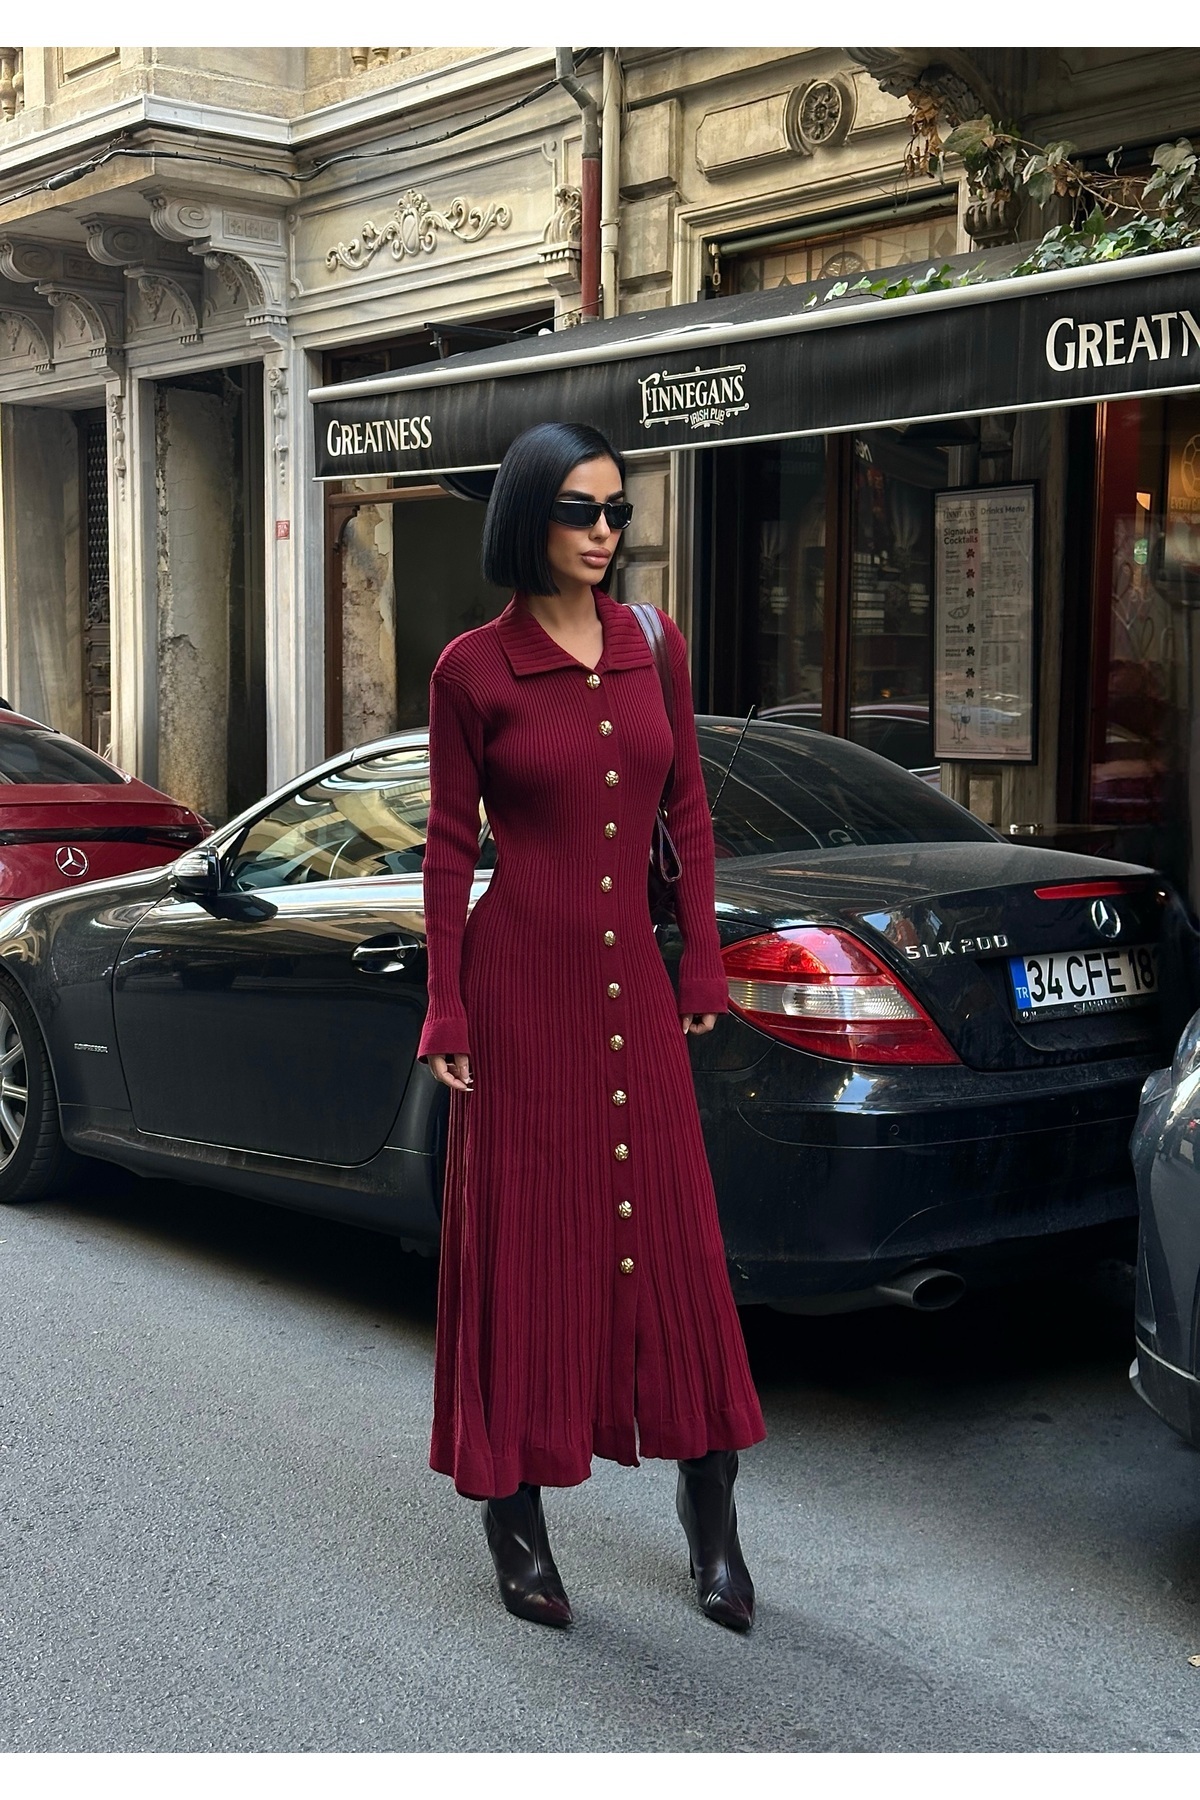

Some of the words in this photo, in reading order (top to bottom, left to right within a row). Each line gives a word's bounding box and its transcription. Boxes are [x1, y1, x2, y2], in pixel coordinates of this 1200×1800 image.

[638, 373, 745, 424] FINNEGANS
[690, 408, 709, 426] IRISH
[710, 408, 726, 422] PUB
[326, 415, 433, 457] GREATNESS
[981, 506, 1004, 515] Drinks
[1005, 505, 1025, 513] Menu
[944, 527, 979, 538] Signature
[944, 535, 979, 545] Cocktails
[905, 940, 956, 960] SLK
[960, 934, 1009, 954] 200
[1027, 958, 1063, 1003] 34
[1066, 951, 1127, 998] CFE
[1015, 986, 1029, 999] TR
